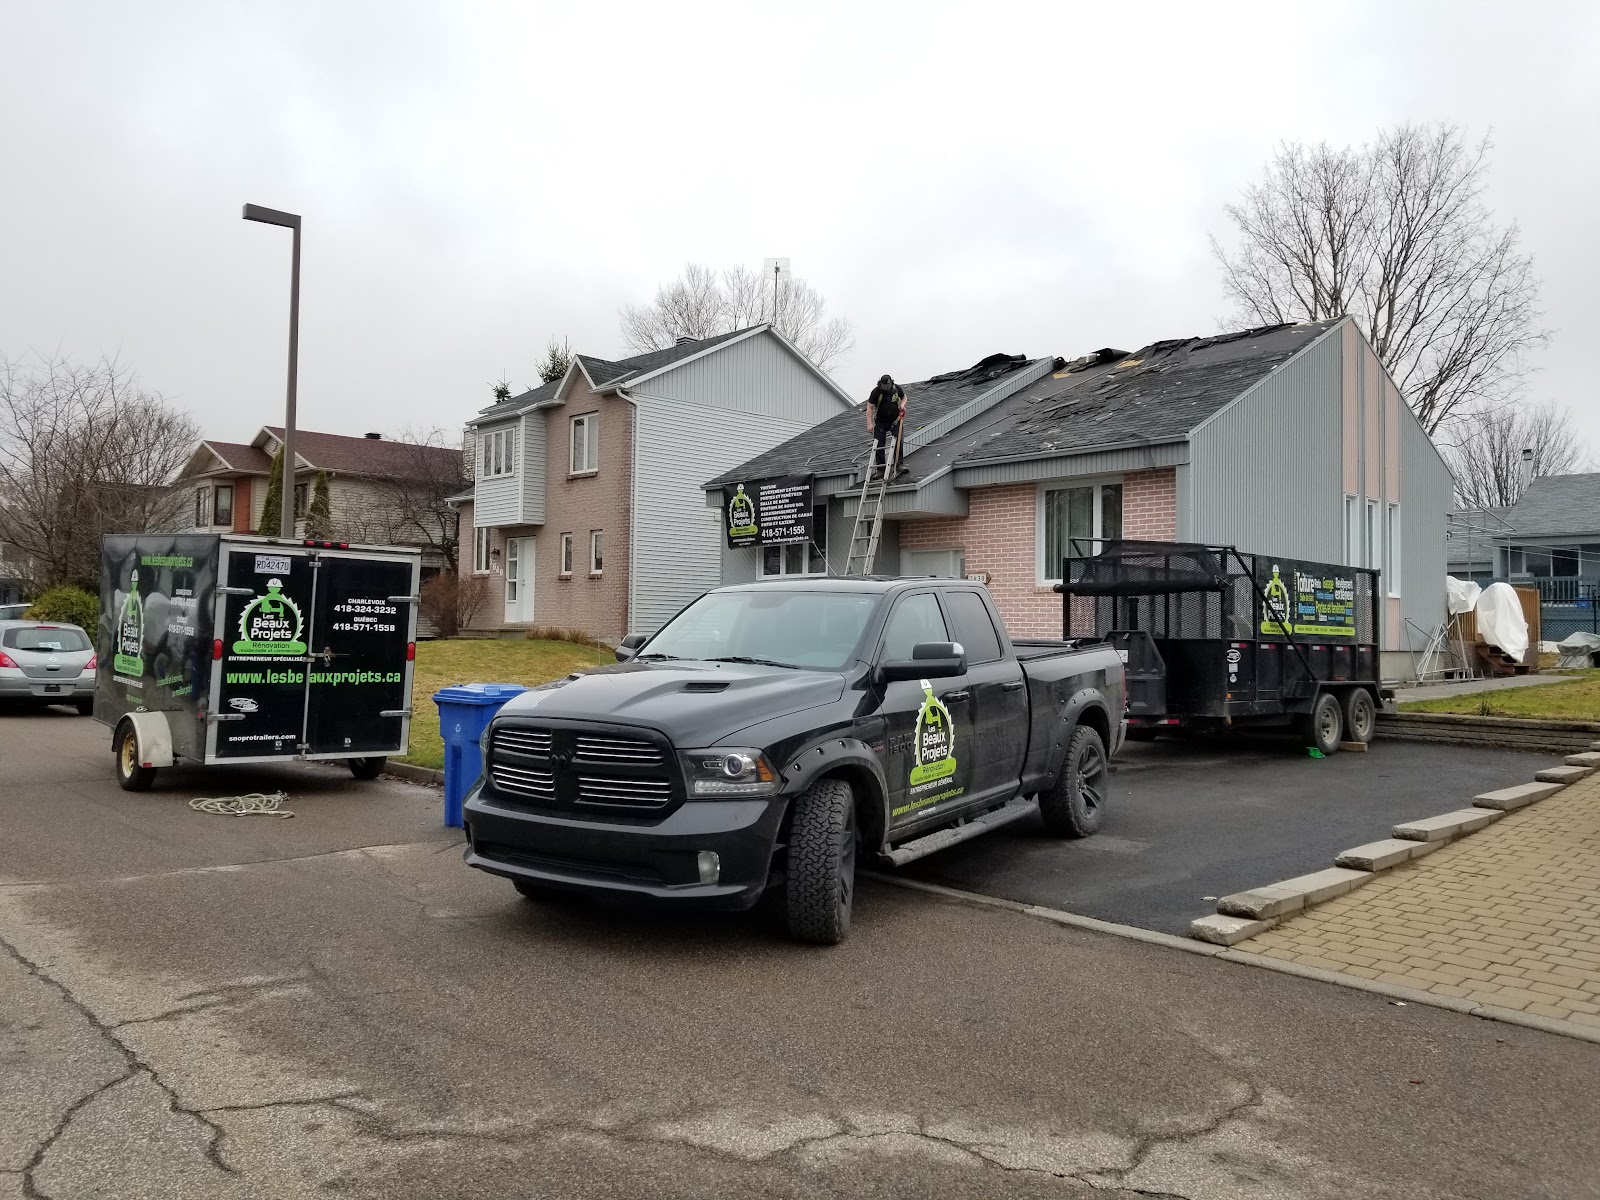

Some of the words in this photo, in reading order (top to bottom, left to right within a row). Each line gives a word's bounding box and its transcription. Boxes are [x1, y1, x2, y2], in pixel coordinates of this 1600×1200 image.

[733, 518, 750, 526] Projets
[761, 526, 805, 537] 418-571-1558
[256, 561, 290, 571] RD4247D
[1296, 571, 1315, 593] Toiture
[347, 598, 386, 606] CHARLEVOIX
[333, 604, 397, 615] 418-324-3232
[253, 617, 290, 628] Beaux
[332, 622, 396, 632] 418-571-1558
[123, 622, 139, 638] Beaux
[168, 623, 195, 637] 418-571-1558
[250, 628, 292, 641] Projets
[121, 636, 139, 655] Projets
[927, 725, 936, 733] Les
[228, 734, 296, 742] snoprotrailers.com
[922, 731, 946, 747] Beaux
[889, 741, 912, 754] 1500
[921, 744, 948, 762] Projets
[922, 763, 946, 774] Rénovation
[909, 782, 938, 795] ENTREPRENEUR
[892, 787, 964, 816] www.lesbeauxprojets.ca
